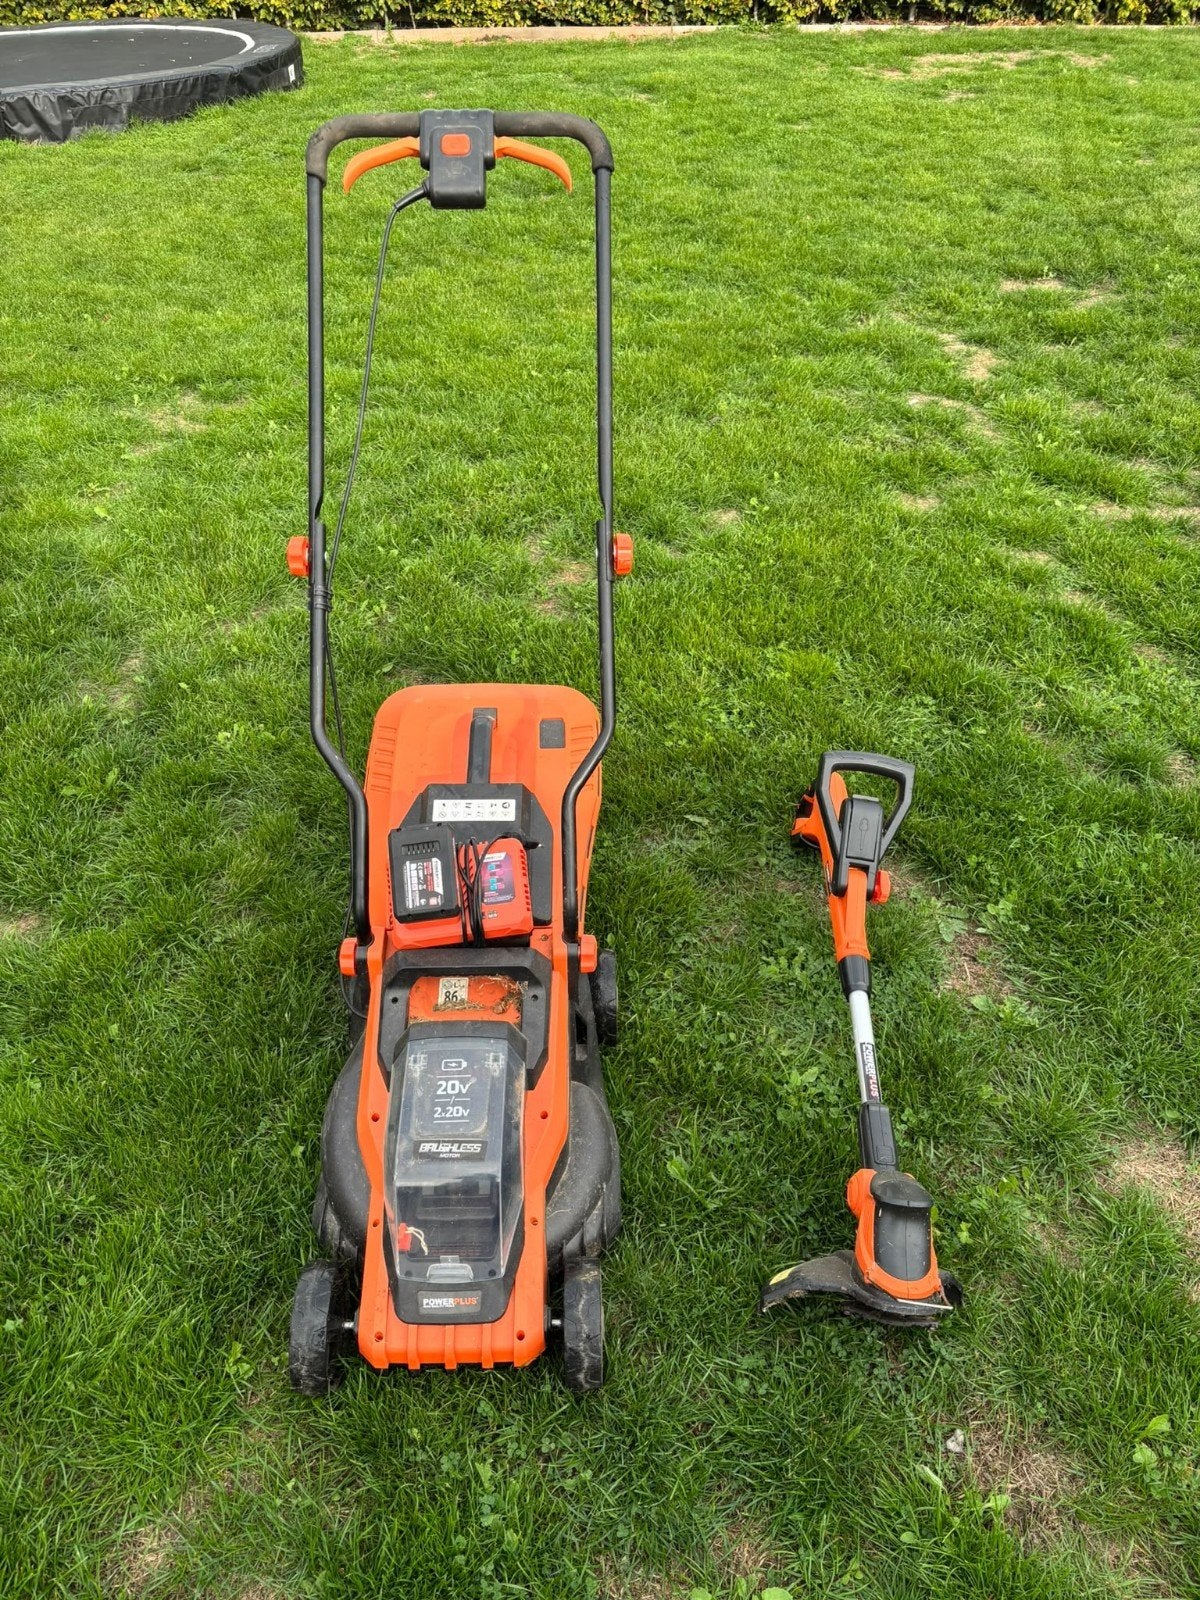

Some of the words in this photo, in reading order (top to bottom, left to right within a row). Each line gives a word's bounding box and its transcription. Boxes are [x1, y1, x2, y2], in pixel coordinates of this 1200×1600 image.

[444, 990, 458, 1002] 86
[865, 1044, 879, 1097] POWERPLUS
[423, 1297, 477, 1305] POWERPLUS
